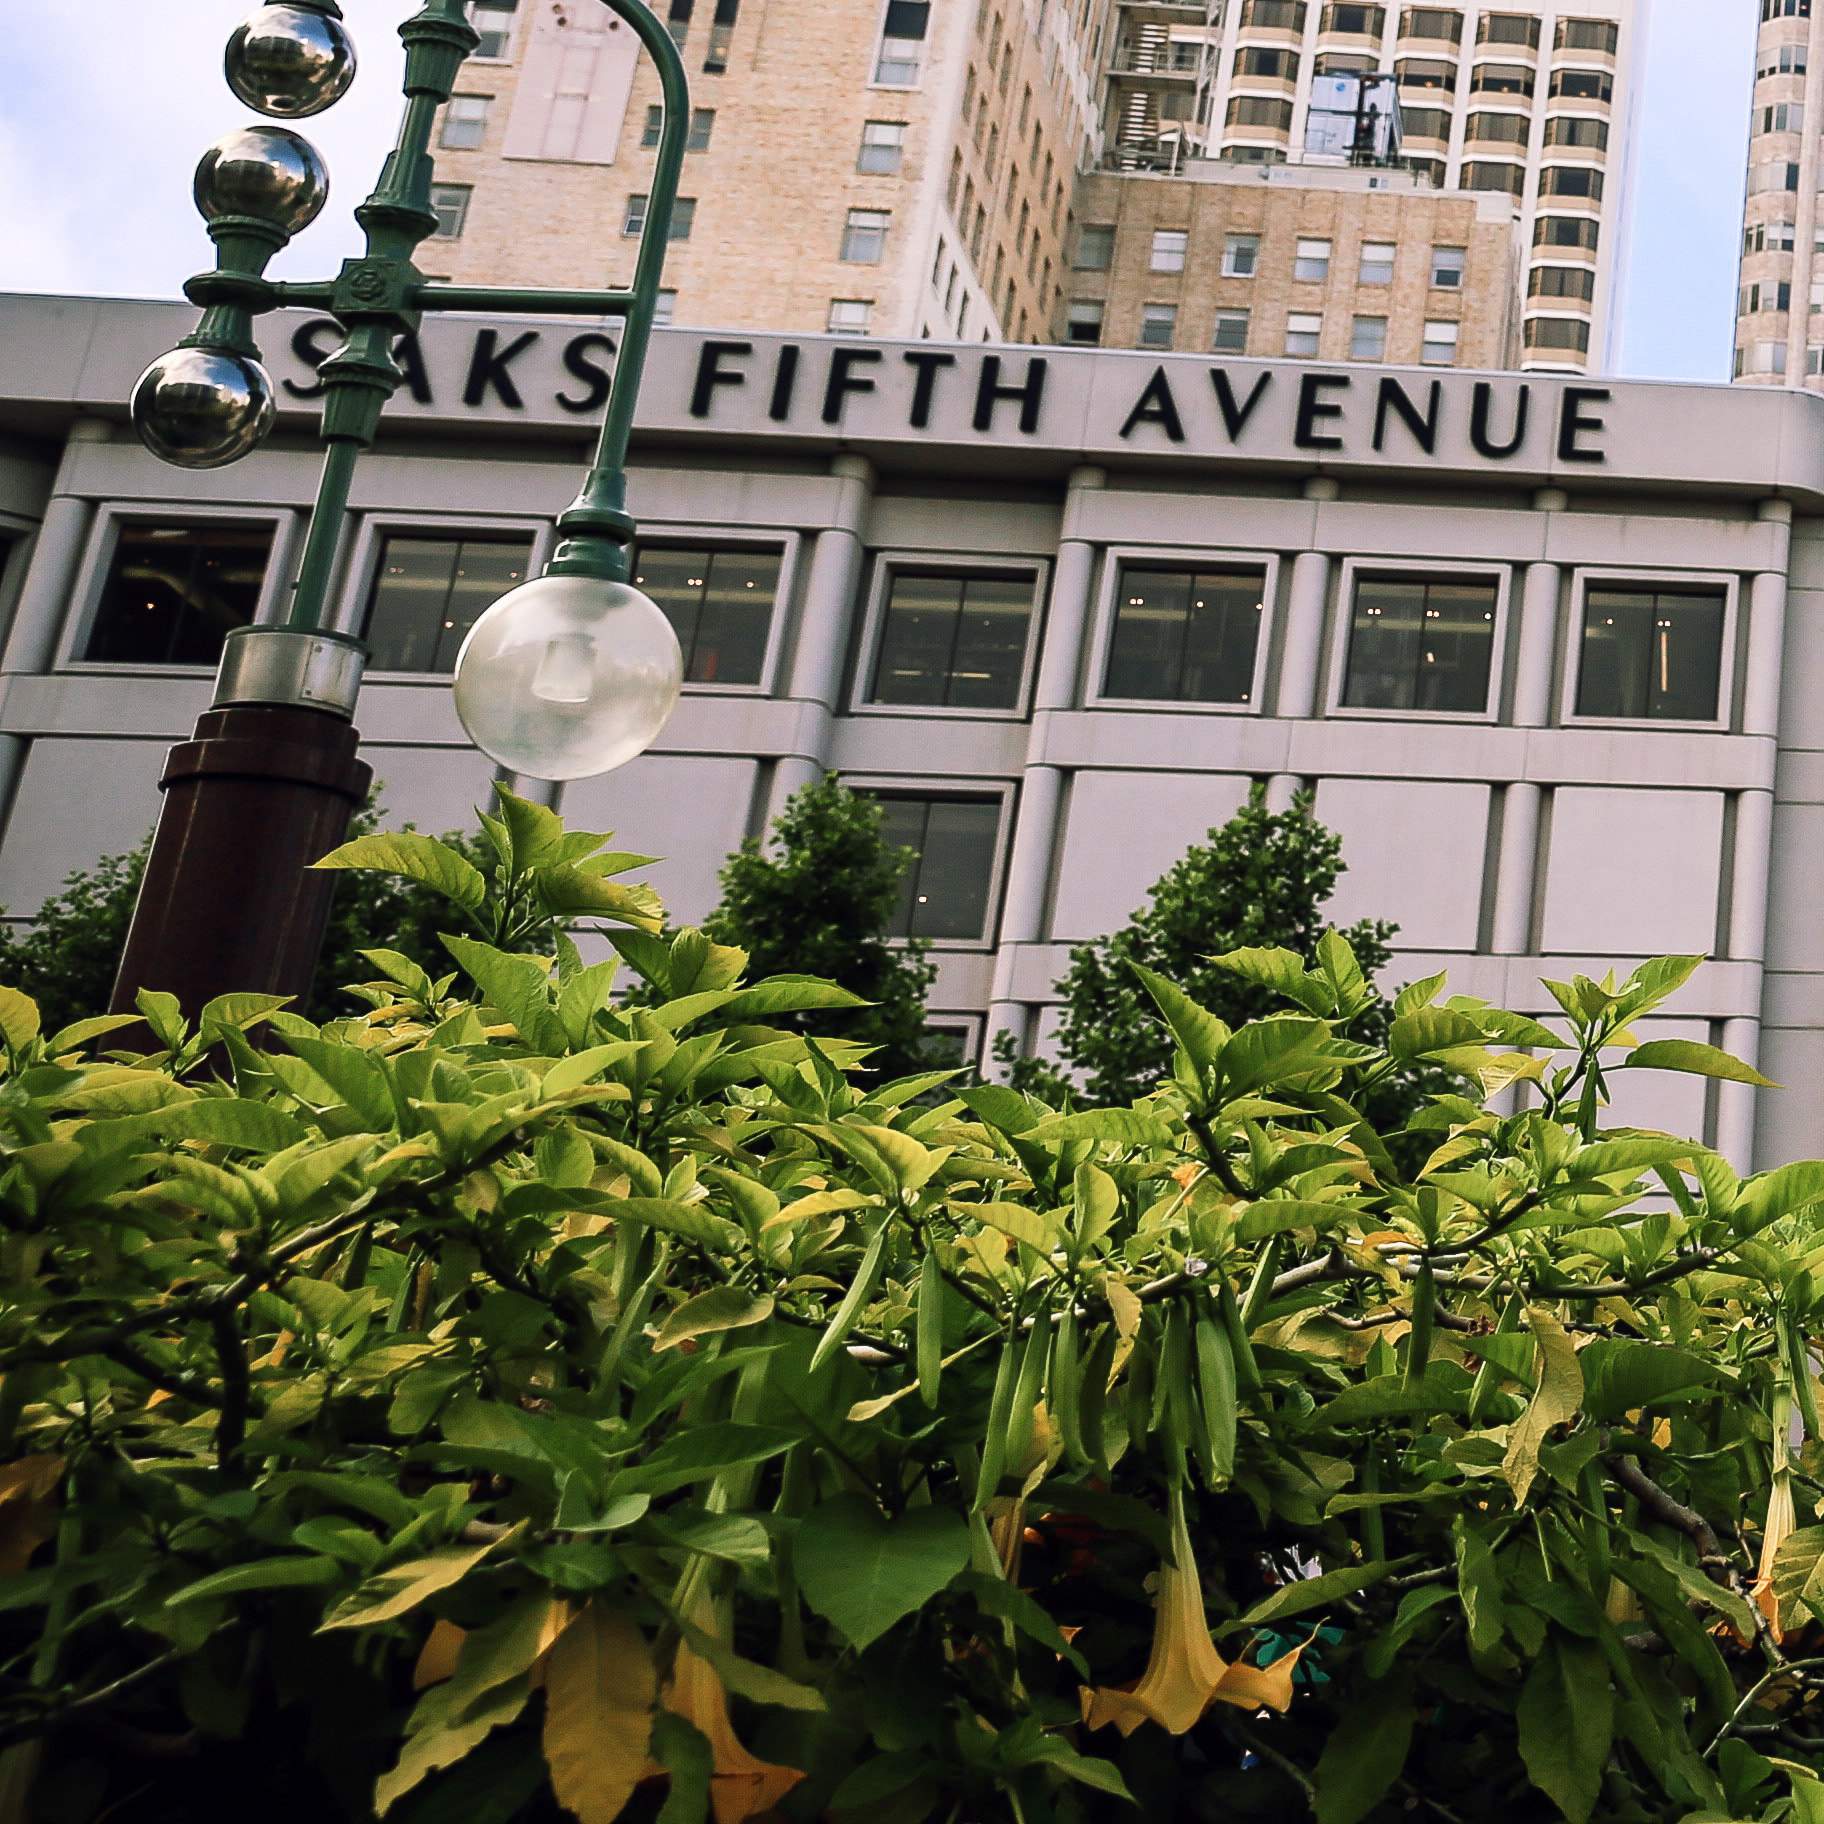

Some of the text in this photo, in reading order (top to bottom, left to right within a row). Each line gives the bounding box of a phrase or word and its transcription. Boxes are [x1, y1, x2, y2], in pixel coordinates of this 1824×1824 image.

[282, 318, 1612, 465] SAKS FIFTH AVENUE
